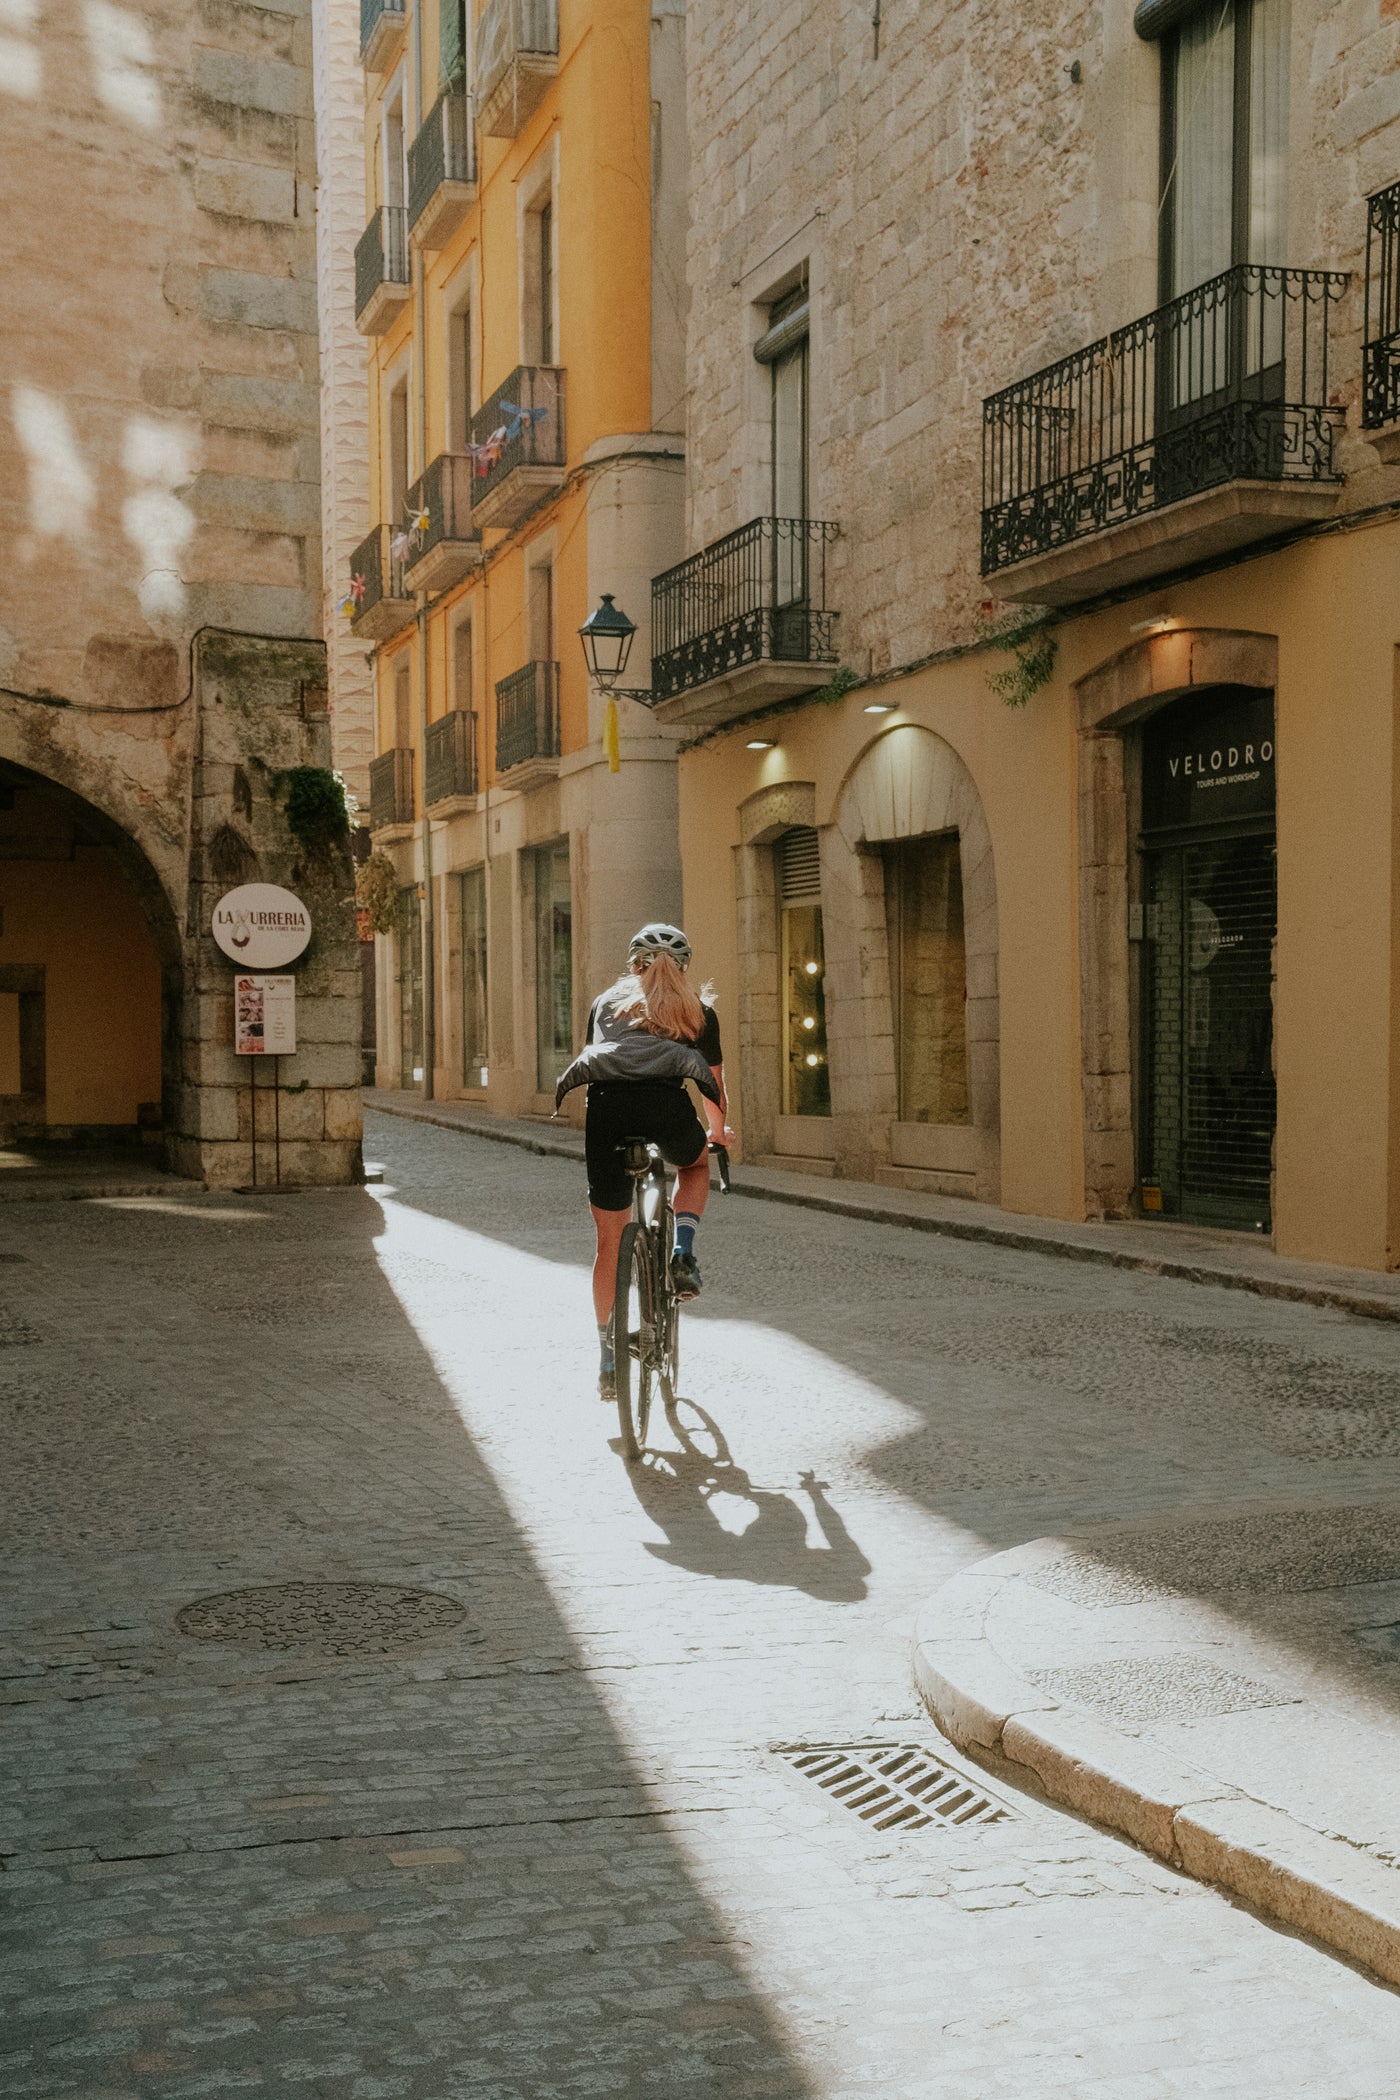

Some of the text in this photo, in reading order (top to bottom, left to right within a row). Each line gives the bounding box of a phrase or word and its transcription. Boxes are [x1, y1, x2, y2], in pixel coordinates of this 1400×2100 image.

[1169, 741, 1273, 777] VELODRO
[1196, 771, 1260, 788] TOURS AND WORKSHOP
[218, 911, 233, 924] LA
